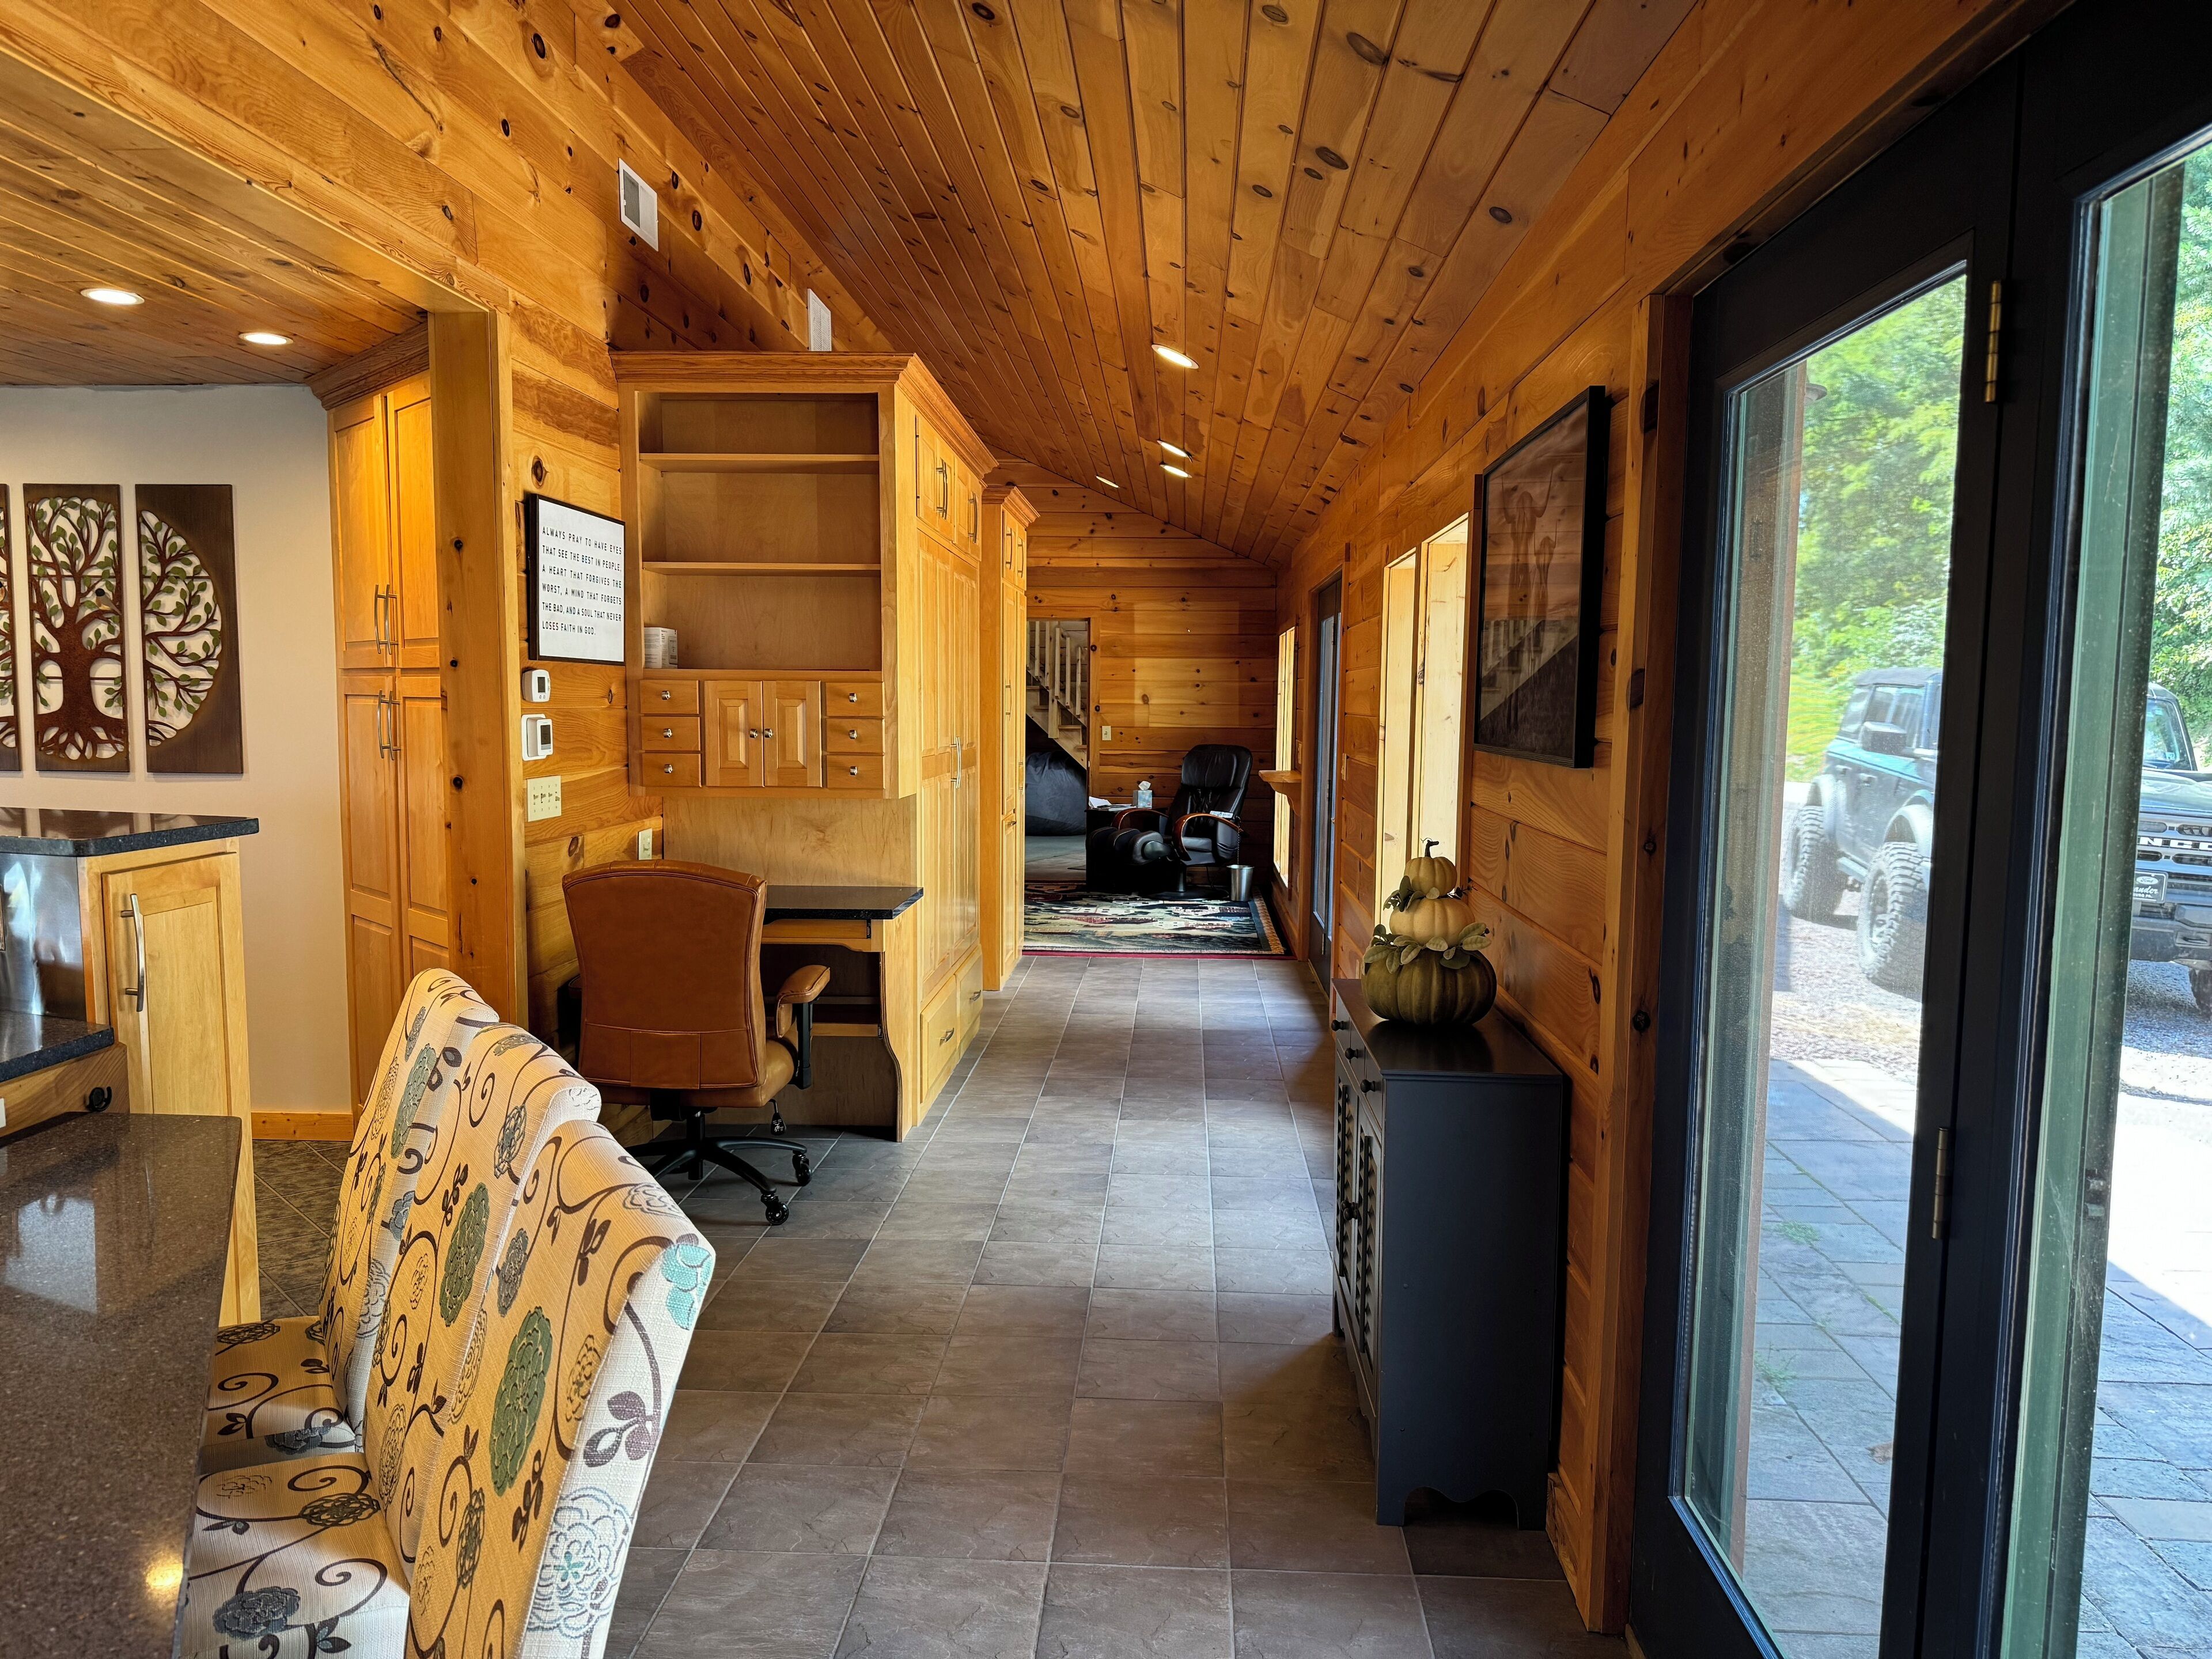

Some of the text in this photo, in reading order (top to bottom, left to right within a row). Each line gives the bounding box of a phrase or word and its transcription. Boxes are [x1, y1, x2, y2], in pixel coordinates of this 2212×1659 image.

[542, 526, 622, 555] ALWAYS PRAY TO HAVE EYES
[542, 545, 622, 573] THAT SEE THE BEST IN PEOPLE,
[542, 564, 622, 588] A HEART THAT FORGIVES THE
[542, 582, 622, 605] WORST, A MIND THAT FORGETS
[542, 602, 551, 611] THE
[553, 604, 565, 614] BAD,
[566, 606, 575, 615] AND
[581, 608, 593, 618] SOUL
[594, 610, 605, 619] THAT
[607, 612, 622, 622] NEVER
[542, 621, 596, 635] LOSES FAITH IN GOD.
[2133, 885, 2158, 894] ander
